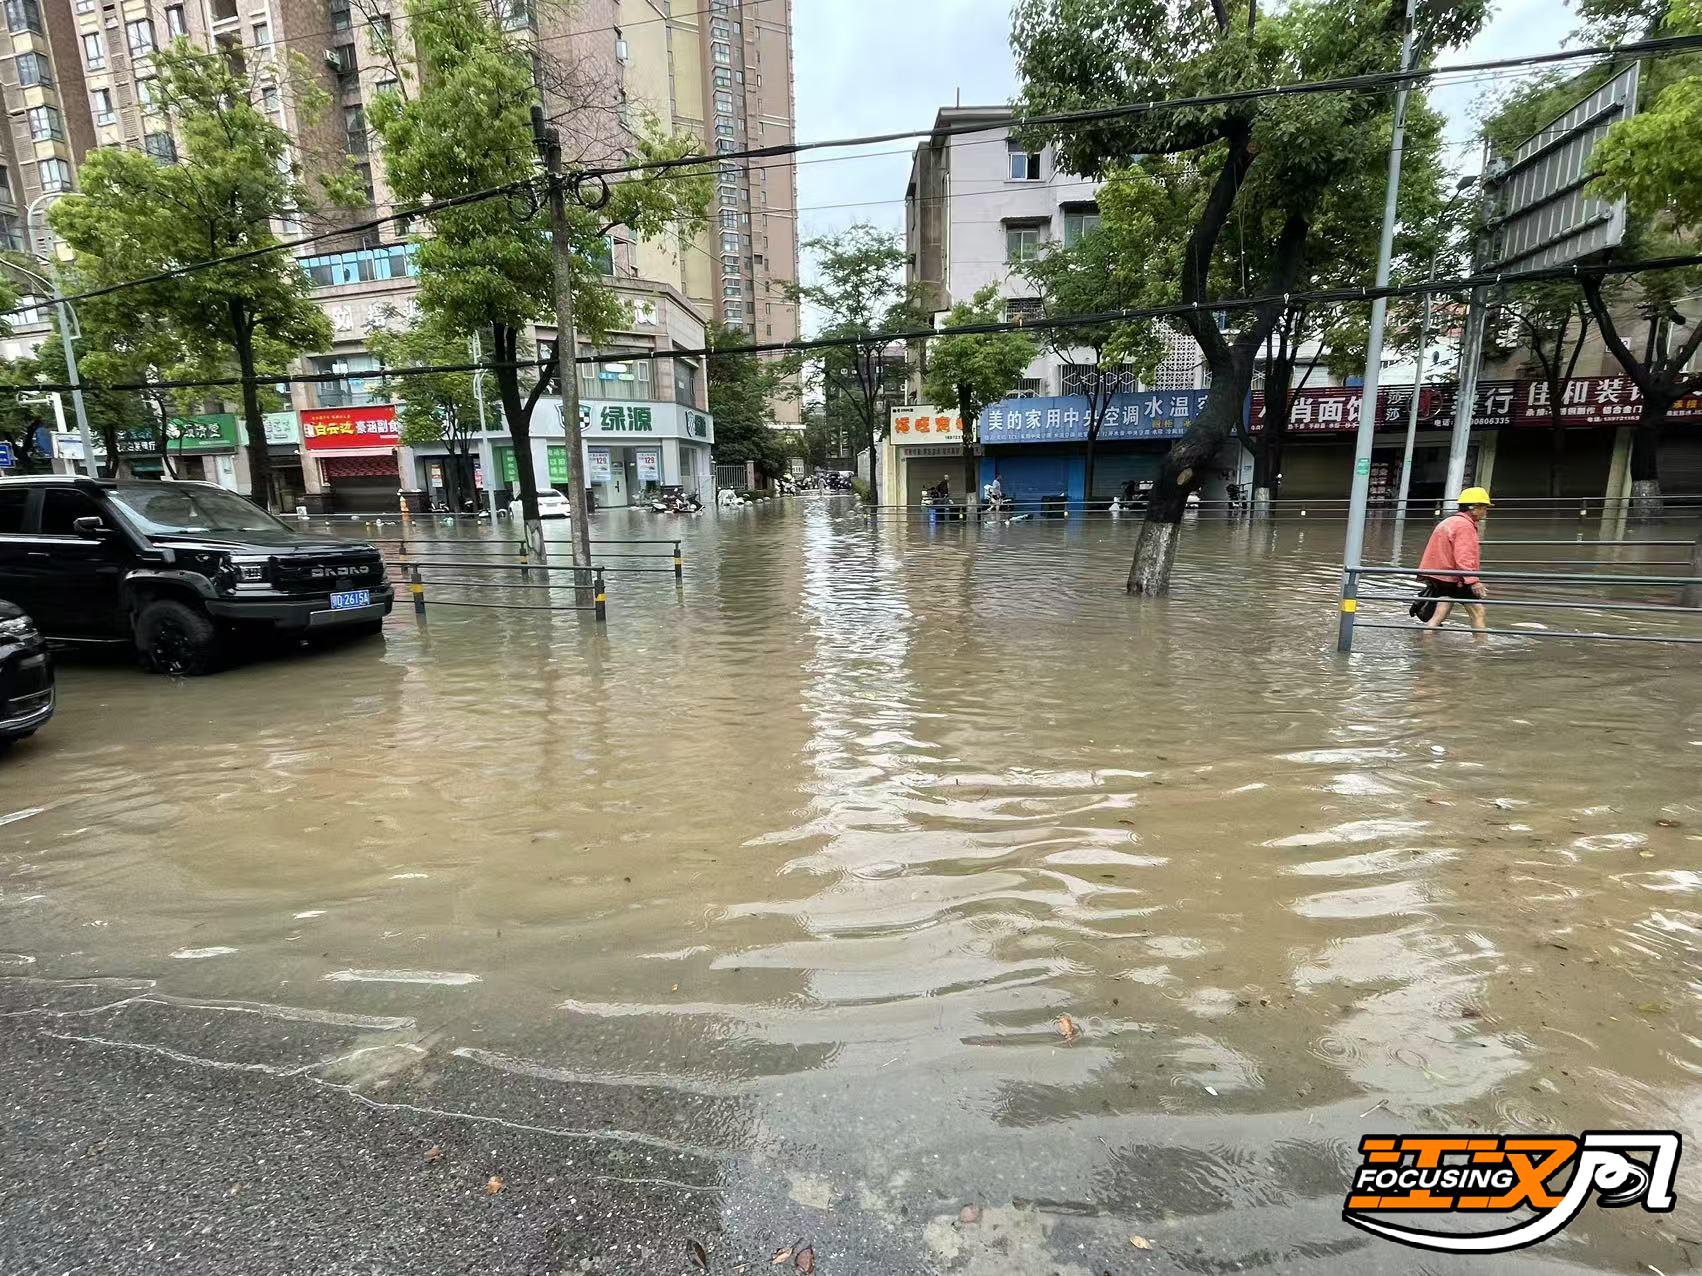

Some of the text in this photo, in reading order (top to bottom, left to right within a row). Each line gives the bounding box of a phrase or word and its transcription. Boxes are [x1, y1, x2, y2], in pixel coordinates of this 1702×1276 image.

[600, 406, 653, 432] 绿源
[988, 405, 1140, 431] 美的家用中央空调
